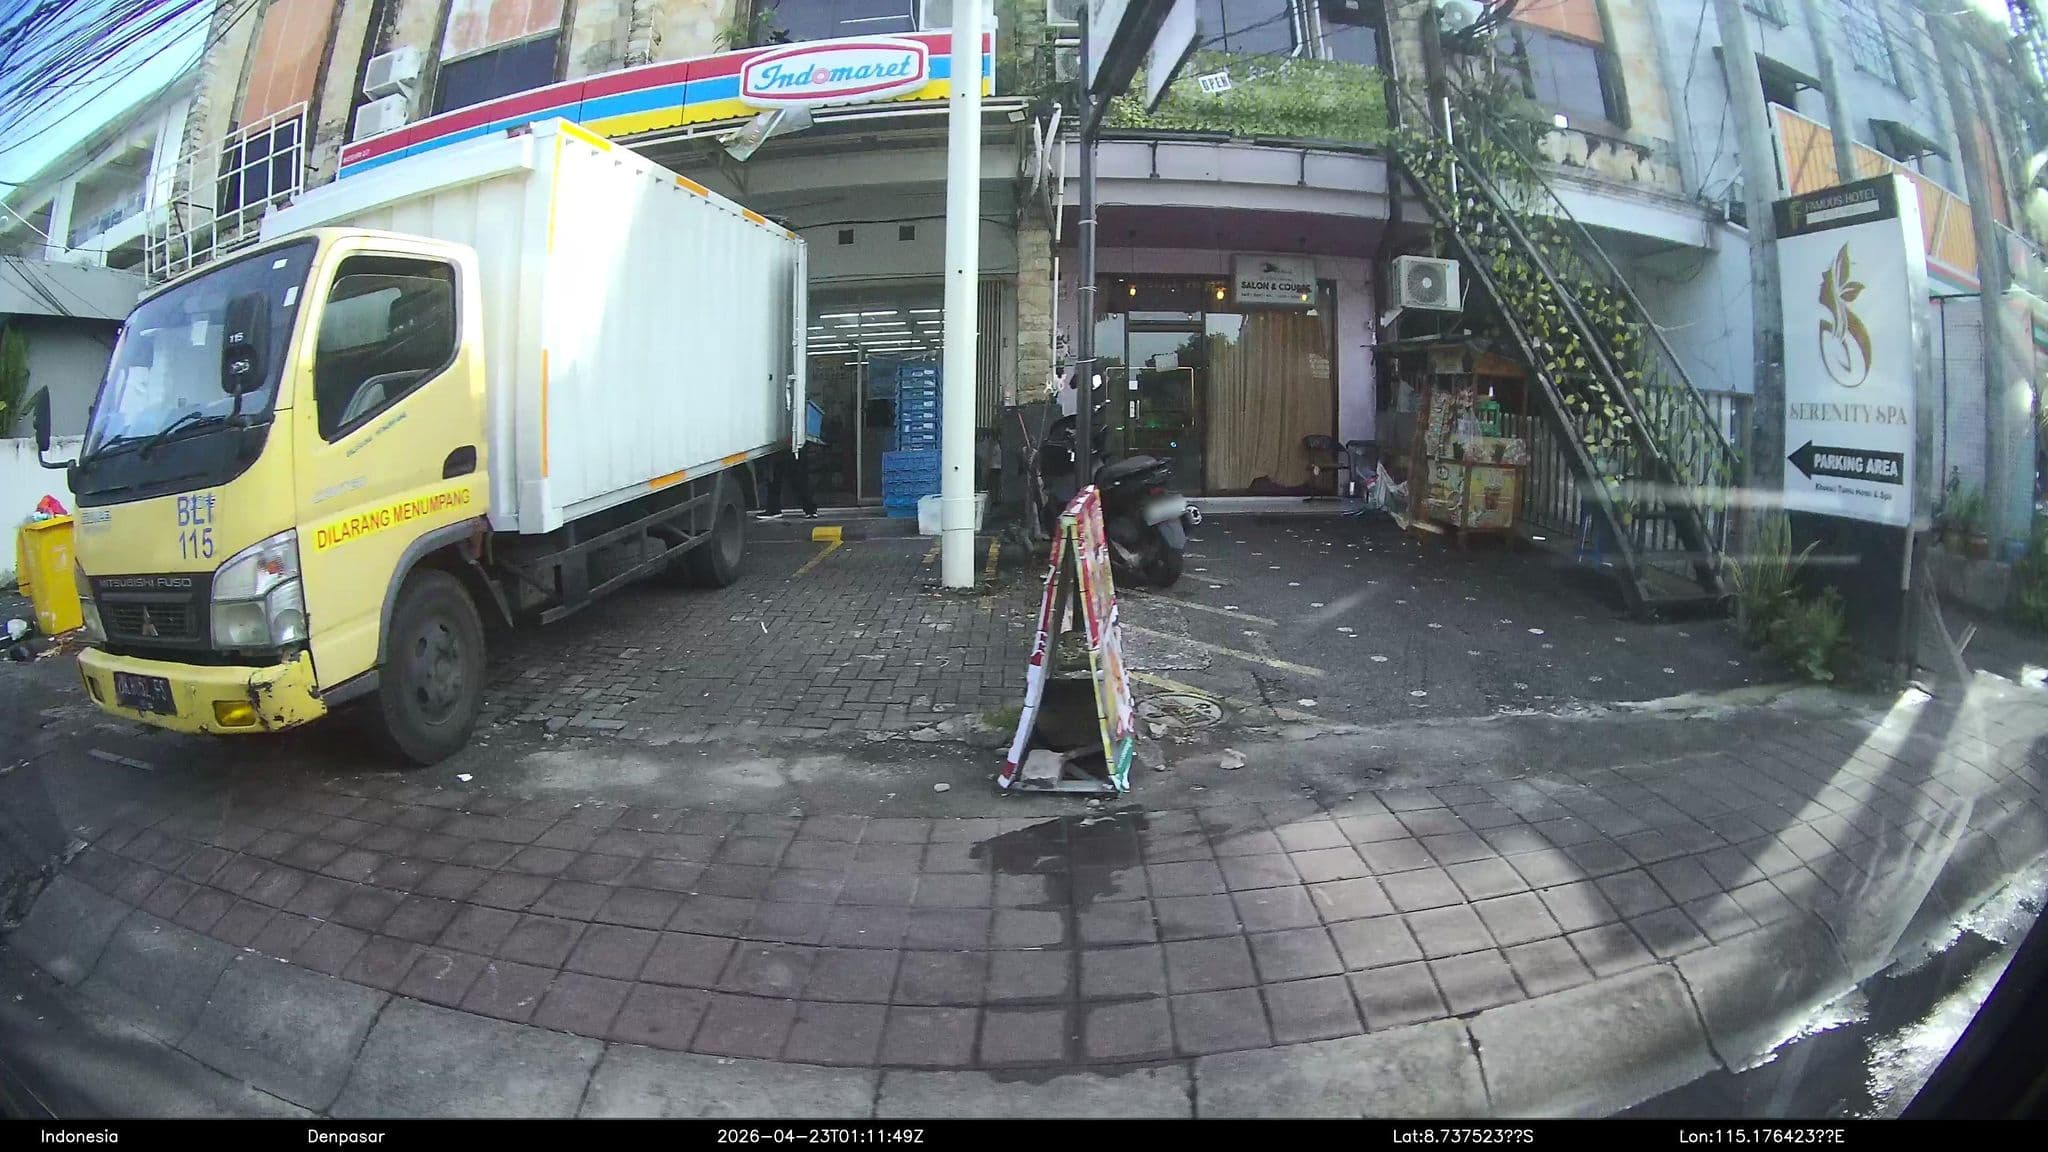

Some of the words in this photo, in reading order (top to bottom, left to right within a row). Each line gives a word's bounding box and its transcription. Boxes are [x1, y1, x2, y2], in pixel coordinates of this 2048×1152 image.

[754, 55, 911, 90] Indomaret
[1202, 76, 1229, 91] OPEN
[1805, 194, 1842, 212] FAMOUS
[1845, 188, 1878, 204] HOTEL
[1241, 281, 1269, 290] SALON
[1271, 282, 1277, 290] &
[1789, 402, 1872, 423] SERENITY
[1876, 405, 1907, 425] SPA
[1814, 453, 1863, 472] PARKING
[1866, 458, 1898, 477] AREA
[317, 509, 390, 549] DILARANG
[394, 488, 471, 523] MENUMPANG
[179, 528, 214, 559] 115
[157, 577, 192, 587] FUSO
